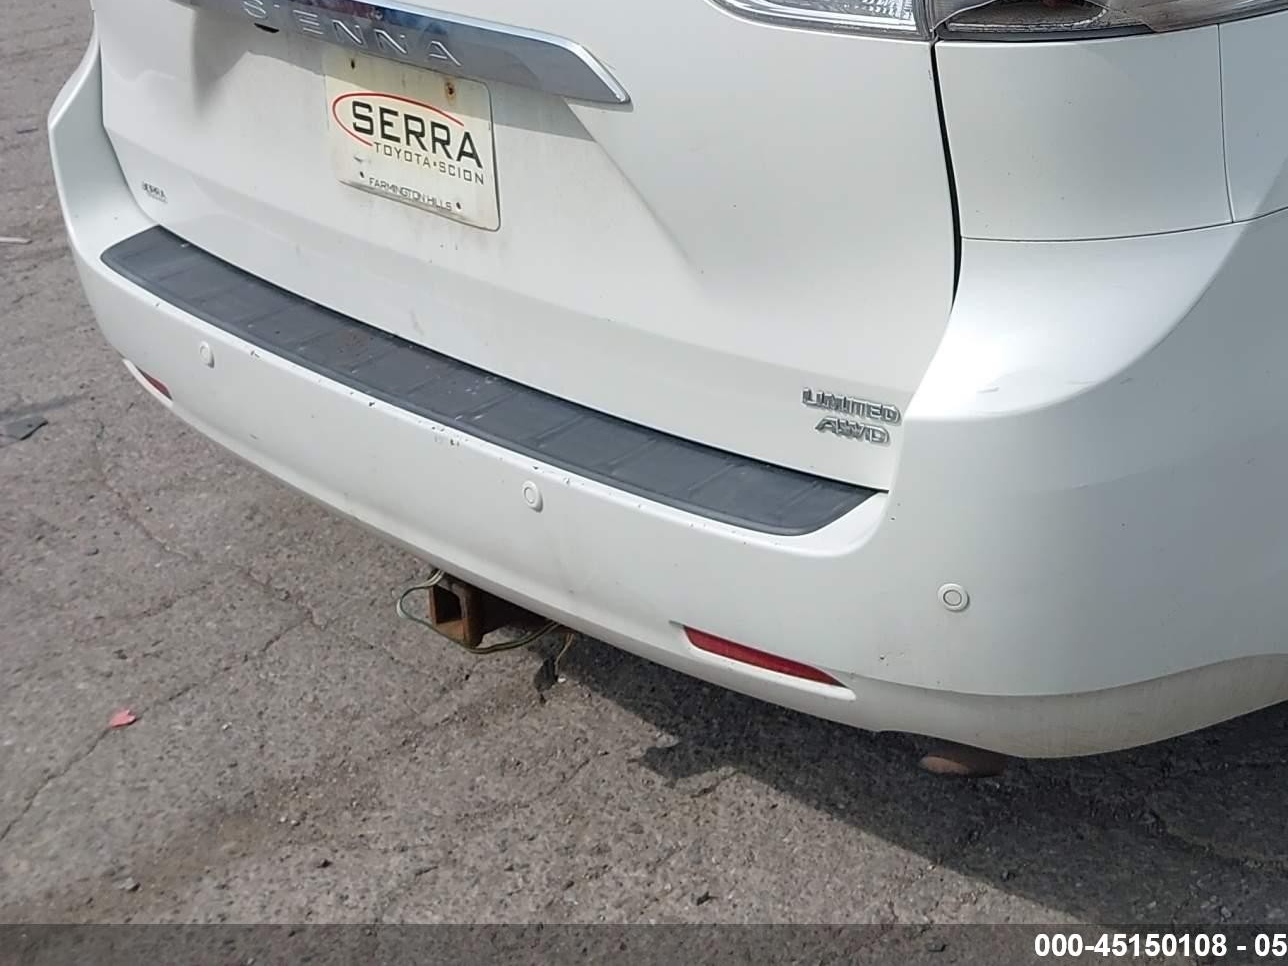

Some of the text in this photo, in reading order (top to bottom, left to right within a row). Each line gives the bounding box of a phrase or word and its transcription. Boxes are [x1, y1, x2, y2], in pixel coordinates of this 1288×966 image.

[351, 100, 484, 169] SERRA
[369, 177, 452, 212] FARMINGTON HILLS
[802, 388, 901, 424] LIMITED
[815, 416, 890, 445] AWD
